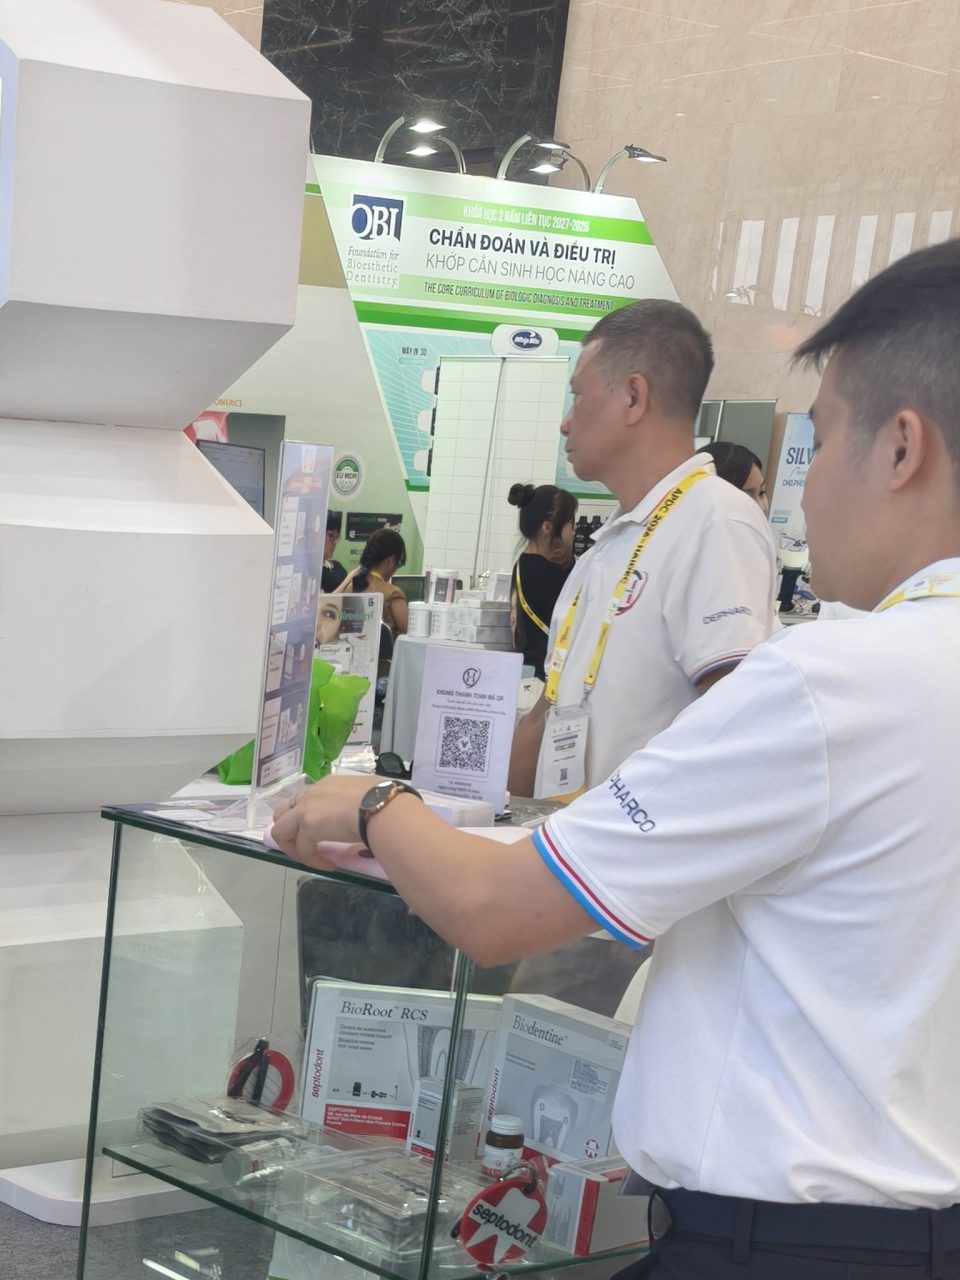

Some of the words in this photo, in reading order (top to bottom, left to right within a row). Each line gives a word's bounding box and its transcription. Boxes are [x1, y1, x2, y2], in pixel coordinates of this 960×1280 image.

[351, 203, 400, 239] OBI
[348, 246, 387, 259] Foundation
[389, 250, 400, 262] for
[429, 226, 477, 249] CHẨN
[480, 232, 525, 255] ĐOÁN
[529, 236, 550, 257] VÀ
[554, 241, 590, 262] ĐIỀU
[593, 248, 616, 269] TRỊ
[346, 271, 397, 287] Dentistry
[347, 259, 398, 273] Bioesthetic
[426, 253, 465, 271] KHỚP
[500, 260, 532, 279] SINH
[535, 265, 566, 285] HỌC
[608, 273, 635, 290] CAO
[424, 282, 437, 293] THE
[437, 284, 454, 296] CORE
[454, 285, 495, 299] CURRICULUM
[496, 289, 504, 300] OF
[565, 296, 579, 307] AND
[579, 297, 613, 310] TREATMENT
[659, 488, 683, 514] APDC
[340, 1001, 392, 1018] BioRoot
[401, 1008, 428, 1021] RCS
[512, 1014, 565, 1046] Biodentine
[312, 1049, 324, 1098] septodont
[487, 1068, 500, 1121] septodont
[472, 1203, 538, 1248] septodont
